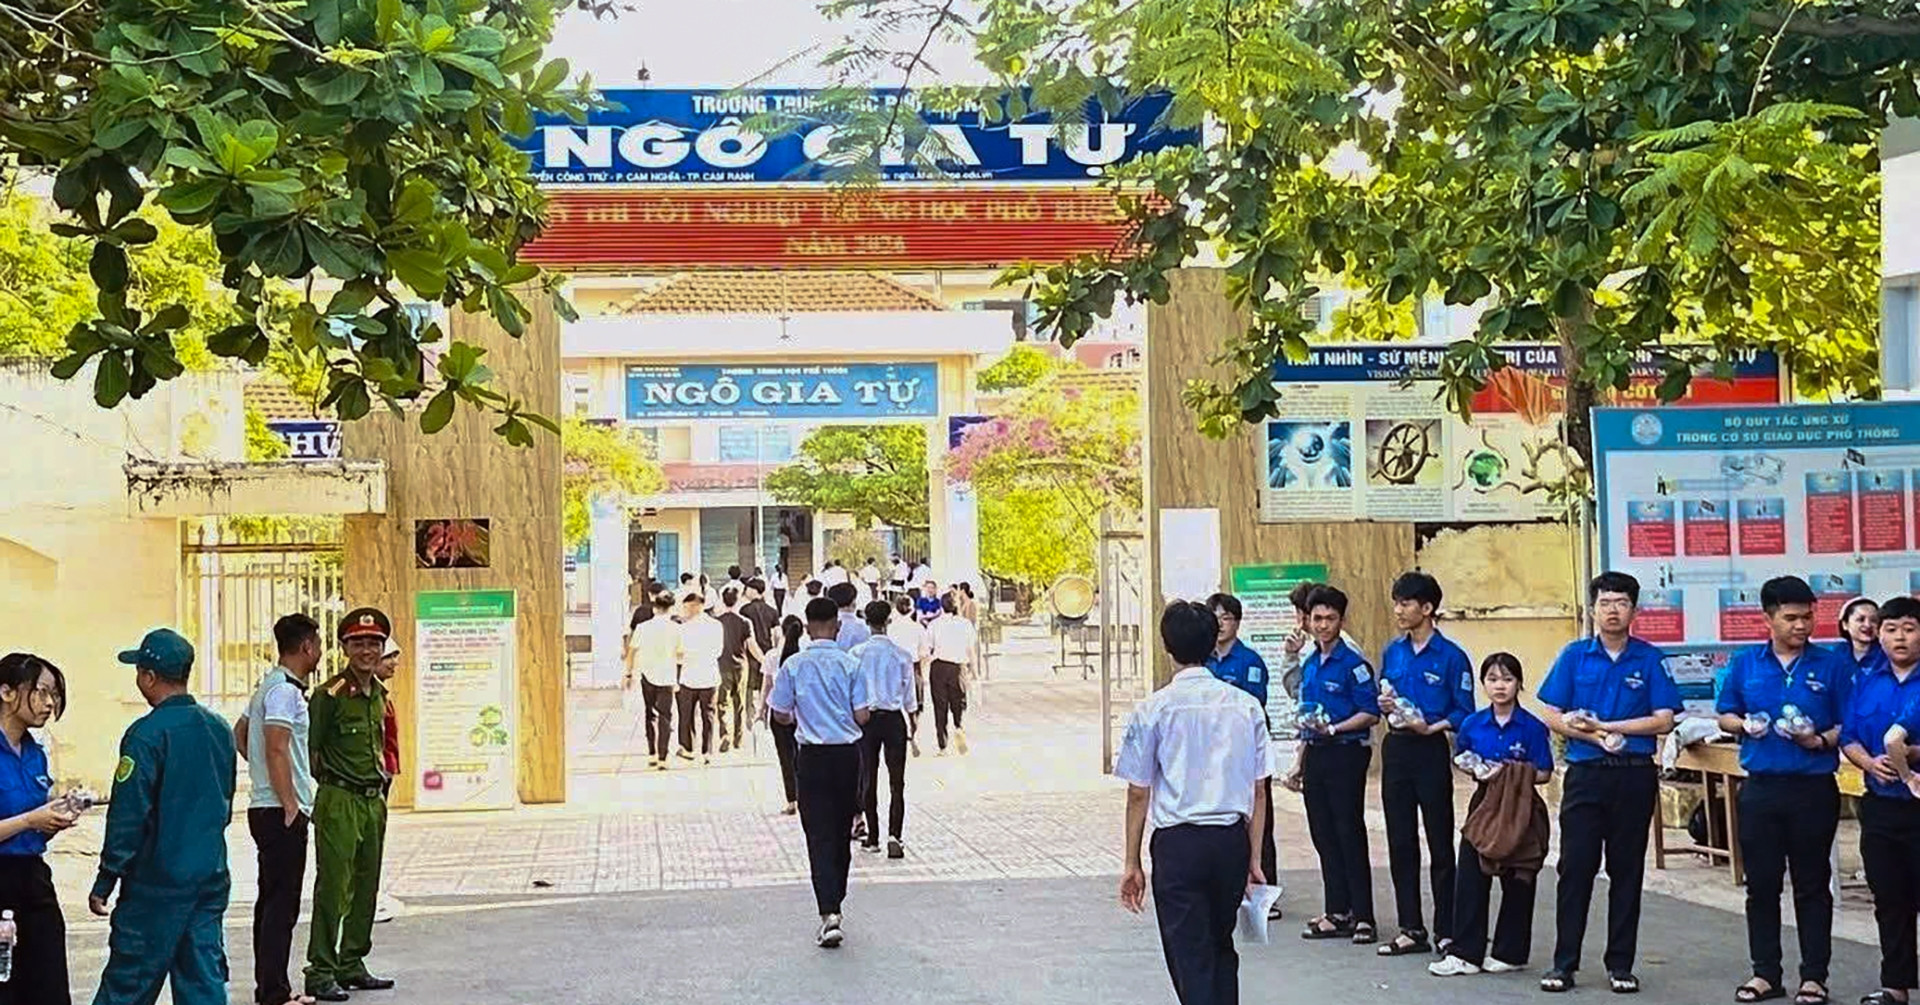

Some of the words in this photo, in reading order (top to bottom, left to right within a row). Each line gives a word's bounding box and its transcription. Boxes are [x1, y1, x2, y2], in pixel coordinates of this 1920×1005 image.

[544, 117, 768, 168] NGÔ
[1009, 123, 1136, 176] TỰ
[1324, 349, 1363, 366] NHÌN
[1524, 347, 1558, 364] CỦA
[643, 376, 740, 405] NGÔ
[751, 382, 843, 405] GIA
[853, 377, 921, 409] TỰ
[1746, 415, 1770, 427] QUY
[1676, 432, 1719, 443] TRONG
[1857, 426, 1900, 439] THÔNG
